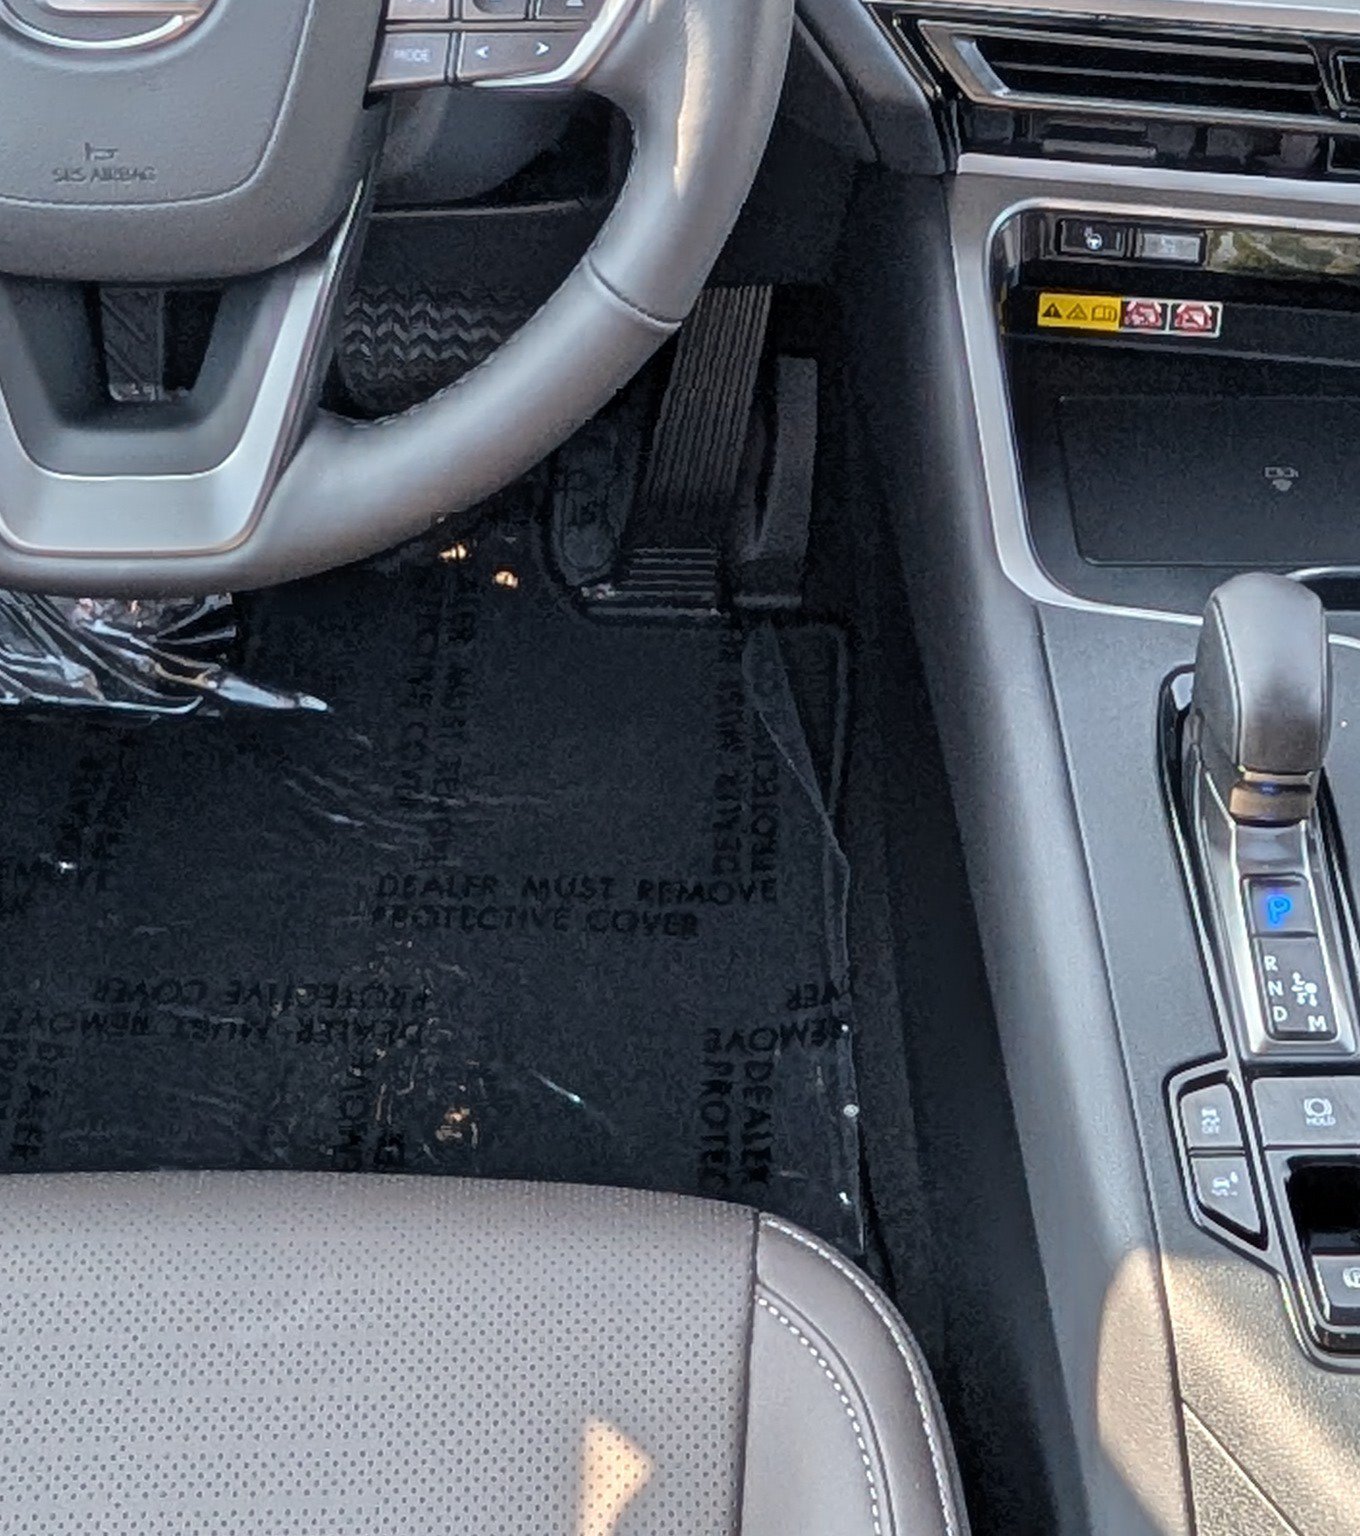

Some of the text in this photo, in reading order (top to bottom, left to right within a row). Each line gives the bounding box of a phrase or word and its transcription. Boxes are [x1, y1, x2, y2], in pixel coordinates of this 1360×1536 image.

[377, 875, 778, 905] DEALER MUST REMOVE
[1267, 896, 1290, 924] P
[371, 903, 698, 939] PROTECTIVE COVER
[1264, 955, 1278, 971] R
[1268, 981, 1283, 996] N
[1274, 1007, 1288, 1022] D
[1308, 1016, 1327, 1031] M
[1306, 1117, 1336, 1127] HOLD
